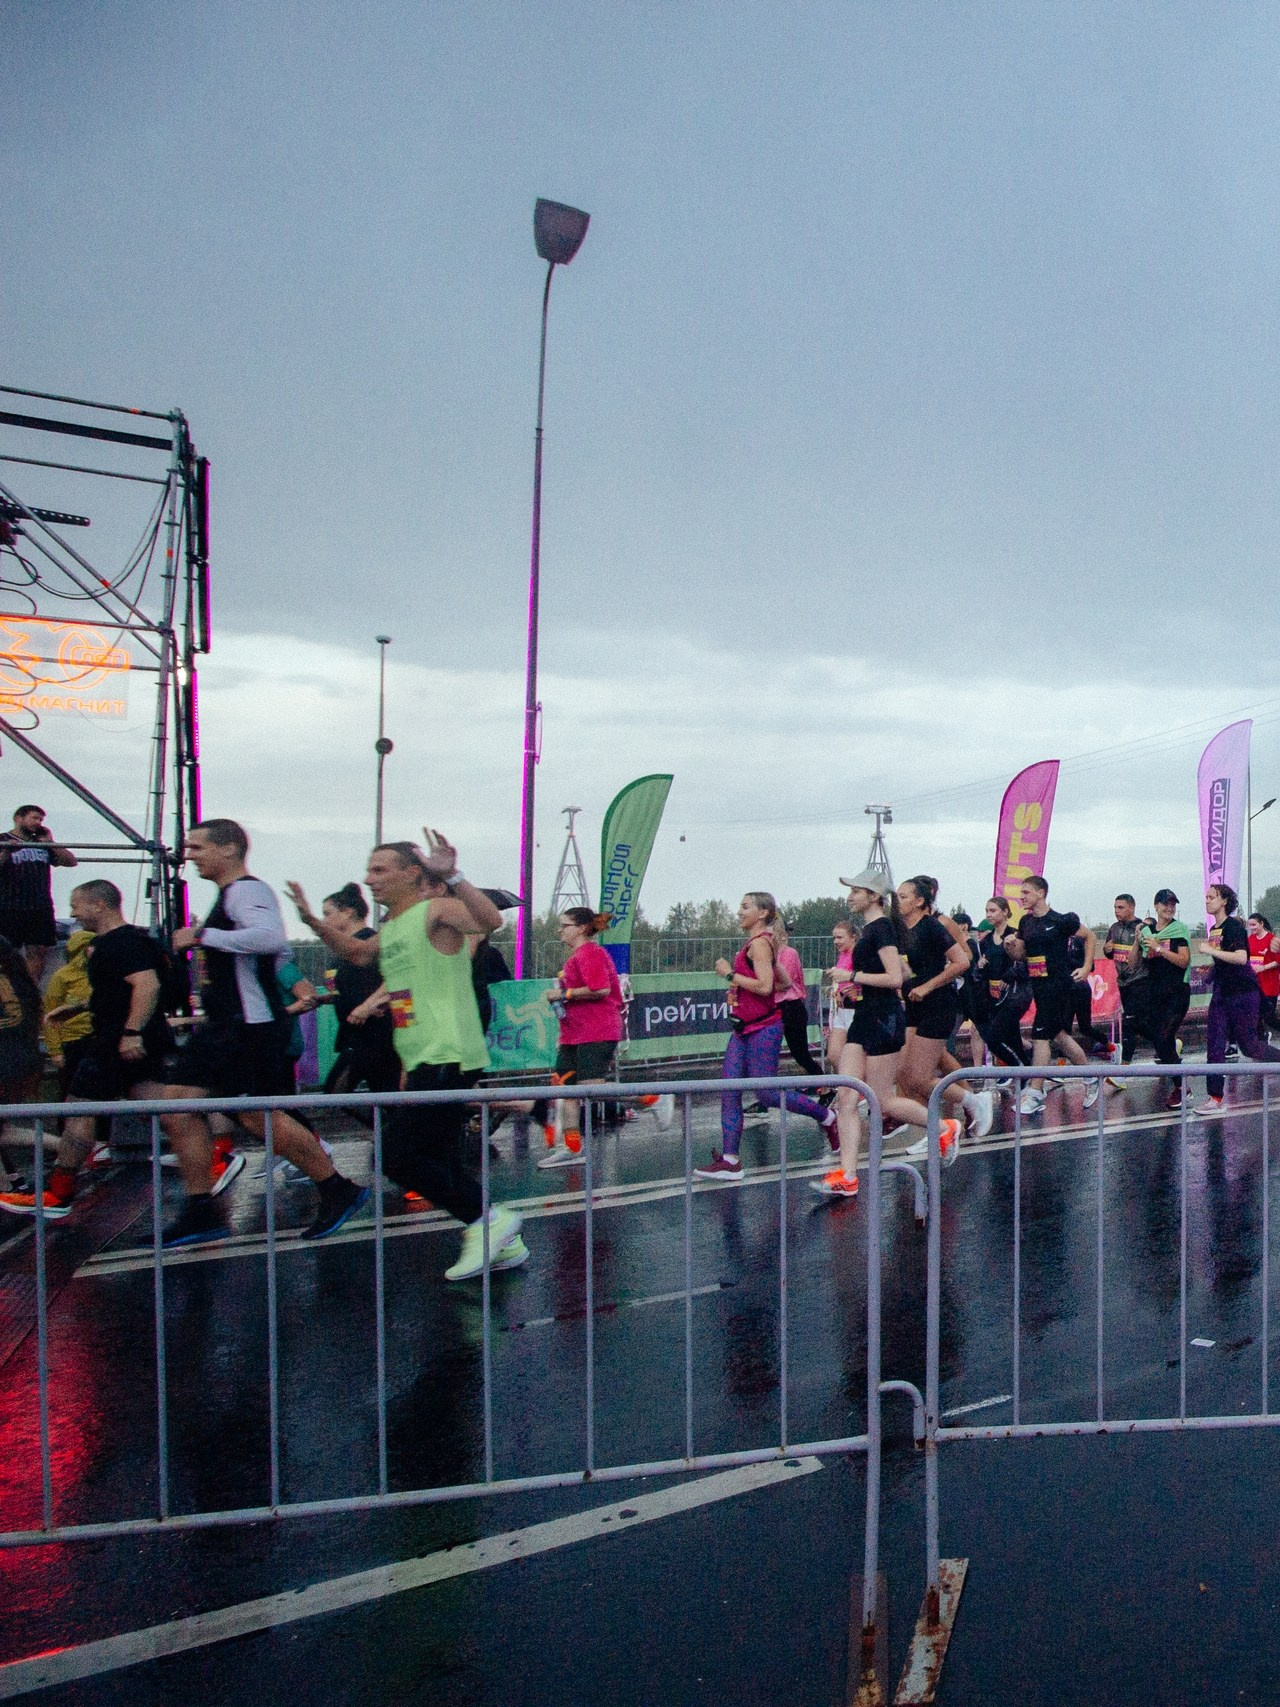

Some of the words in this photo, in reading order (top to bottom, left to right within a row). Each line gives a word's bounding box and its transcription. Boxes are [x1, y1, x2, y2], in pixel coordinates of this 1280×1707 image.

[29, 695, 127, 714] МАГНИТ
[1210, 781, 1226, 865] ЛУИДОР
[645, 997, 733, 1032] рейти
